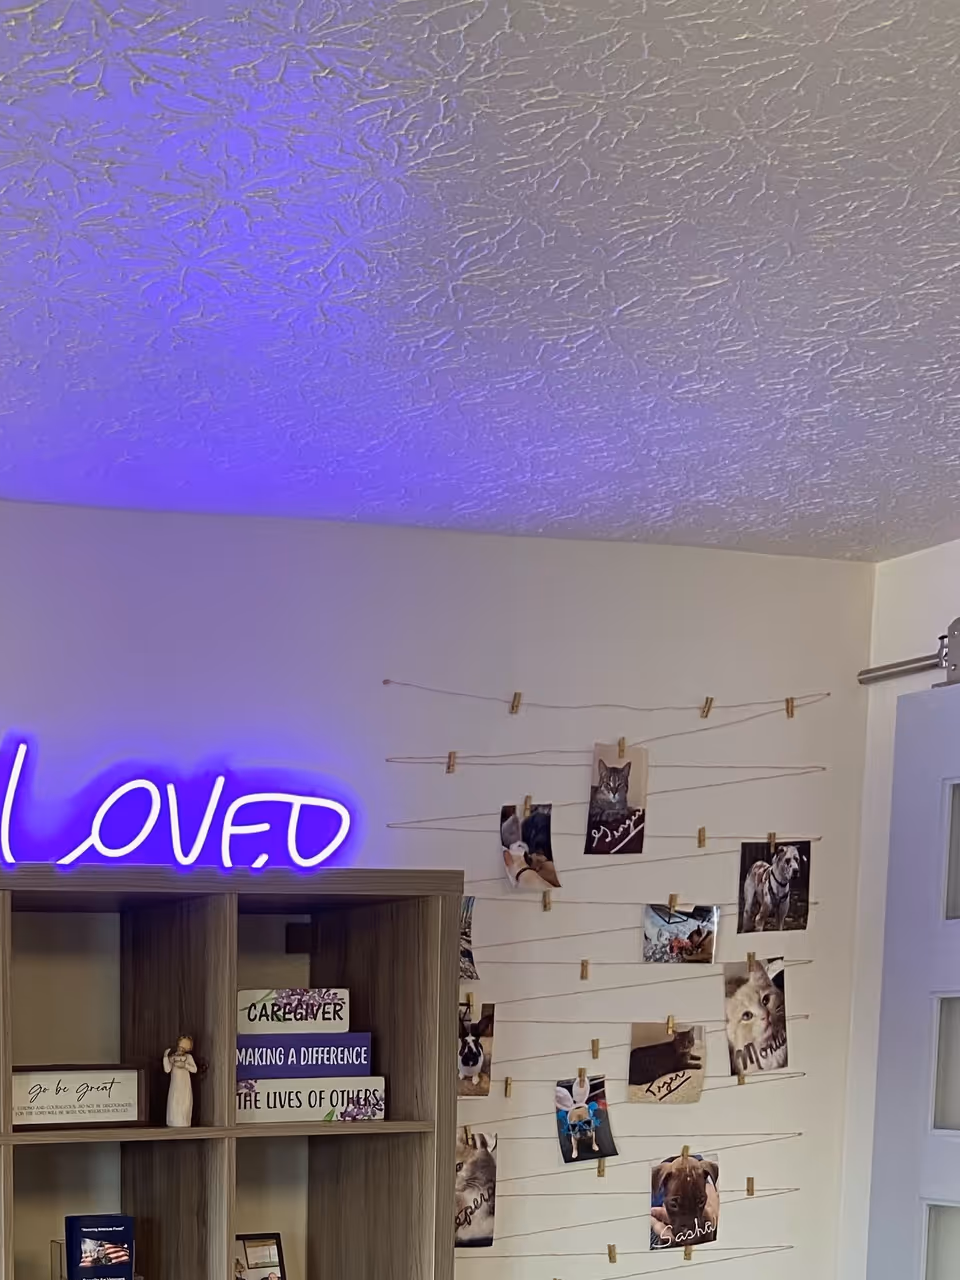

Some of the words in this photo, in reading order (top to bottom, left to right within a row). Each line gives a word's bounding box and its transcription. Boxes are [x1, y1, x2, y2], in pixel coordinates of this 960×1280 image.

[0, 743, 351, 867] LOVED
[247, 1001, 345, 1023] CAREGIVER
[236, 1047, 285, 1066] MAKING
[287, 1048, 297, 1066] A
[300, 1046, 368, 1066] DIFFERENCE
[28, 1084, 50, 1103] go
[55, 1079, 70, 1095] be
[76, 1078, 121, 1103] great
[236, 1091, 261, 1110] THE
[267, 1090, 302, 1109] LIVES
[308, 1090, 325, 1108] OF
[330, 1088, 380, 1107] OTHERS
[652, 1217, 717, 1248] Sasha
